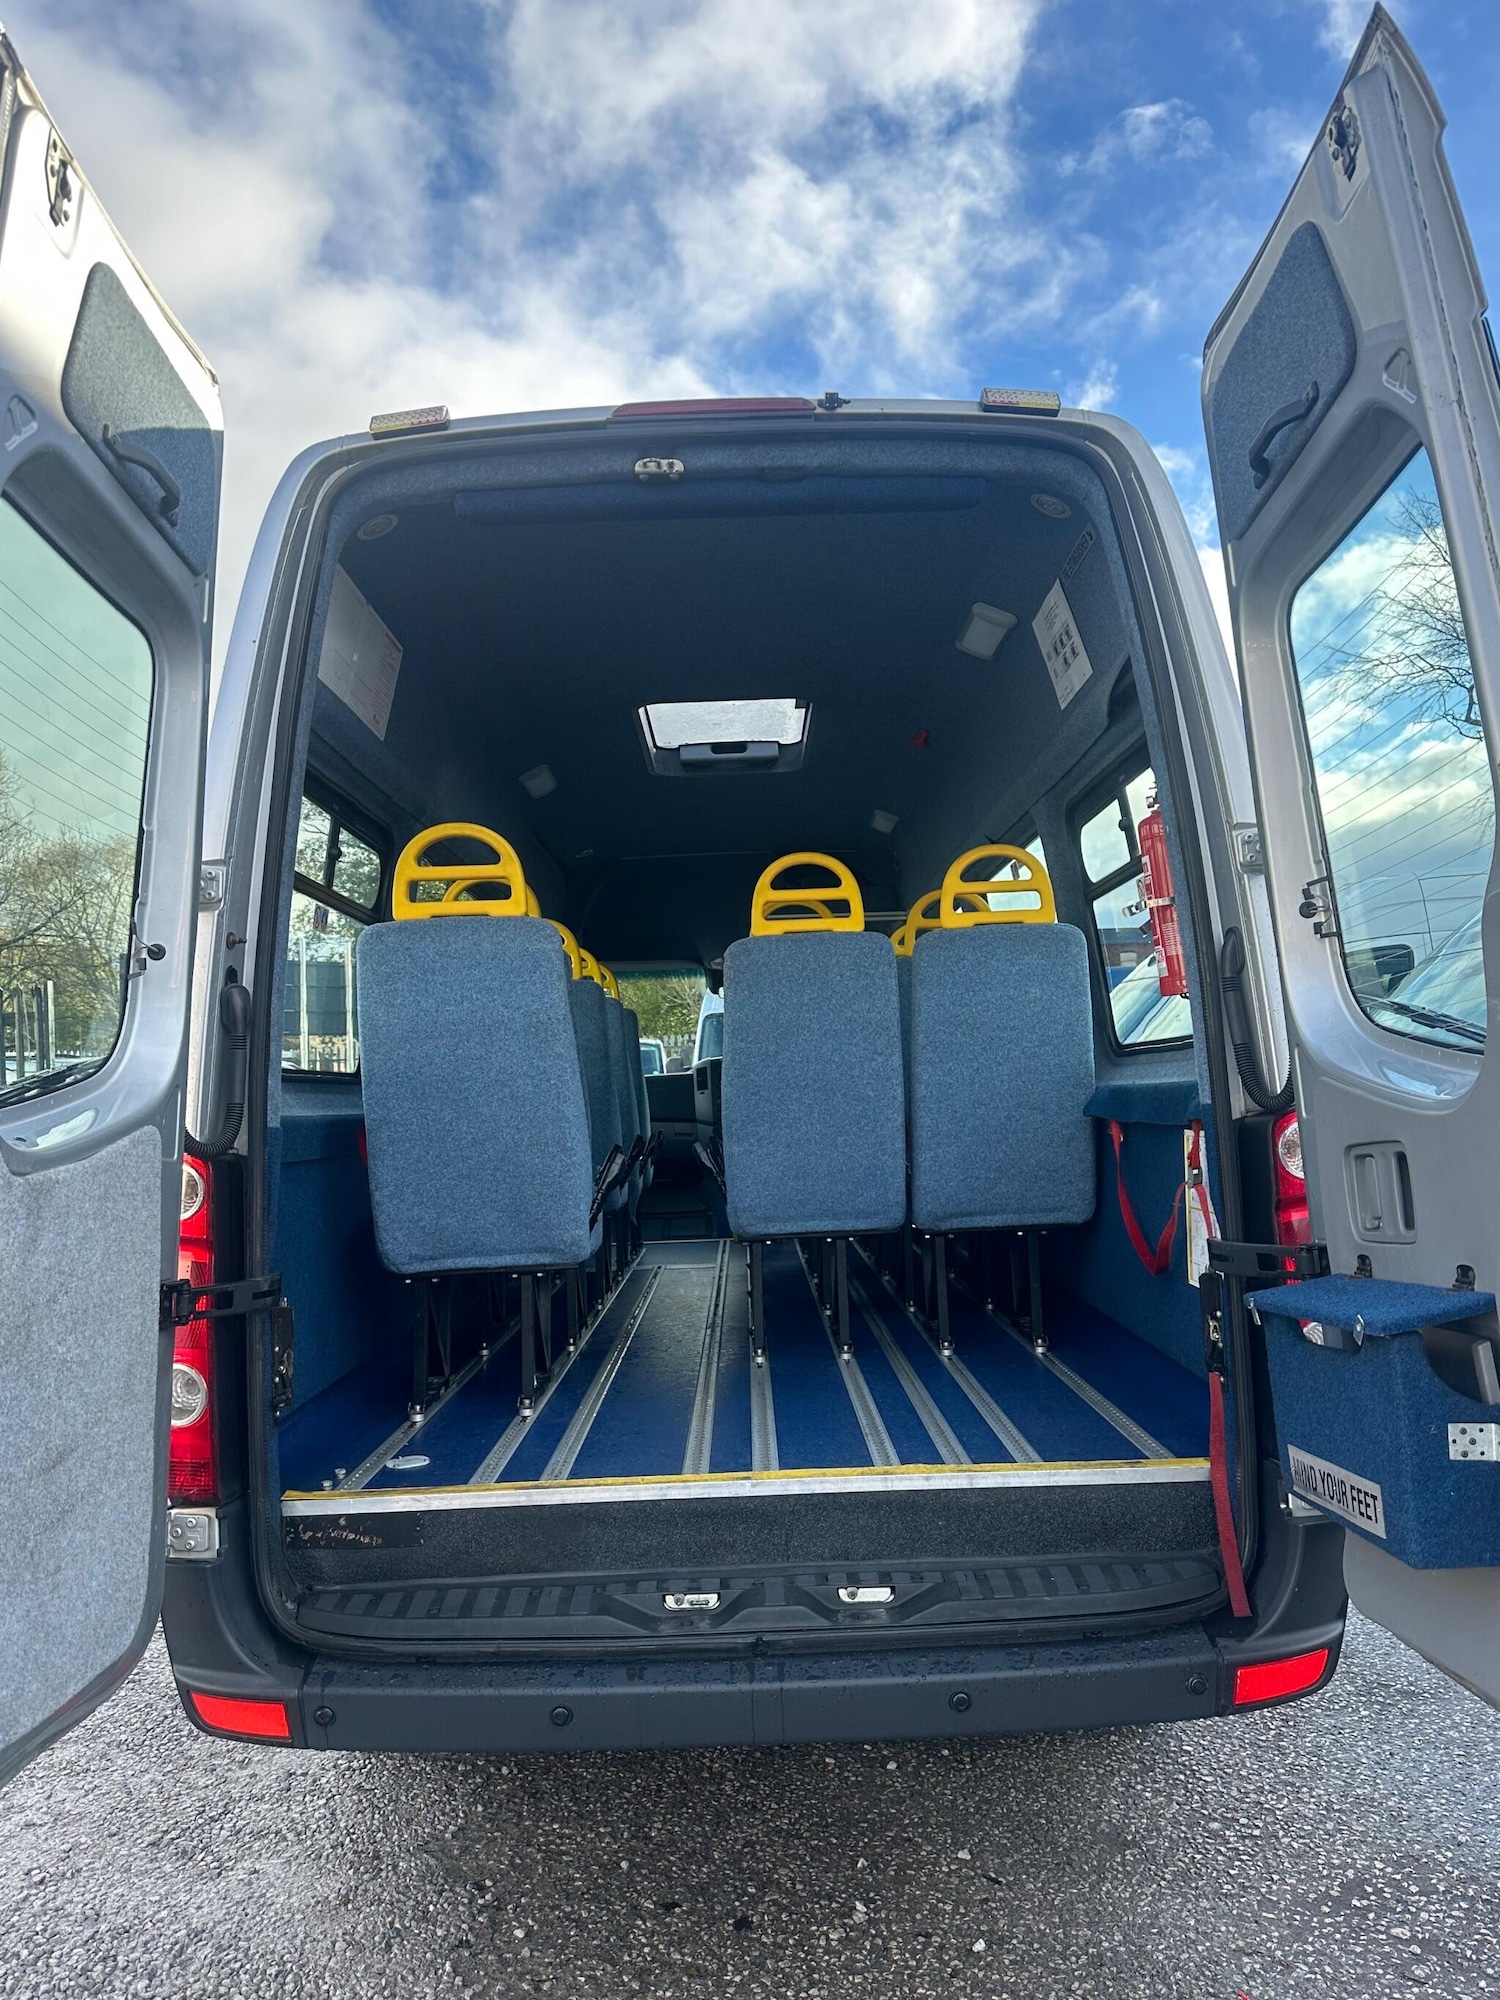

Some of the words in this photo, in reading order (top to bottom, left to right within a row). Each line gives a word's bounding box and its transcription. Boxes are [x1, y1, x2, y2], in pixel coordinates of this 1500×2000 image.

[1292, 1456, 1317, 1492] MIND
[1318, 1469, 1349, 1509] YOUR
[1350, 1484, 1378, 1524] FEET
